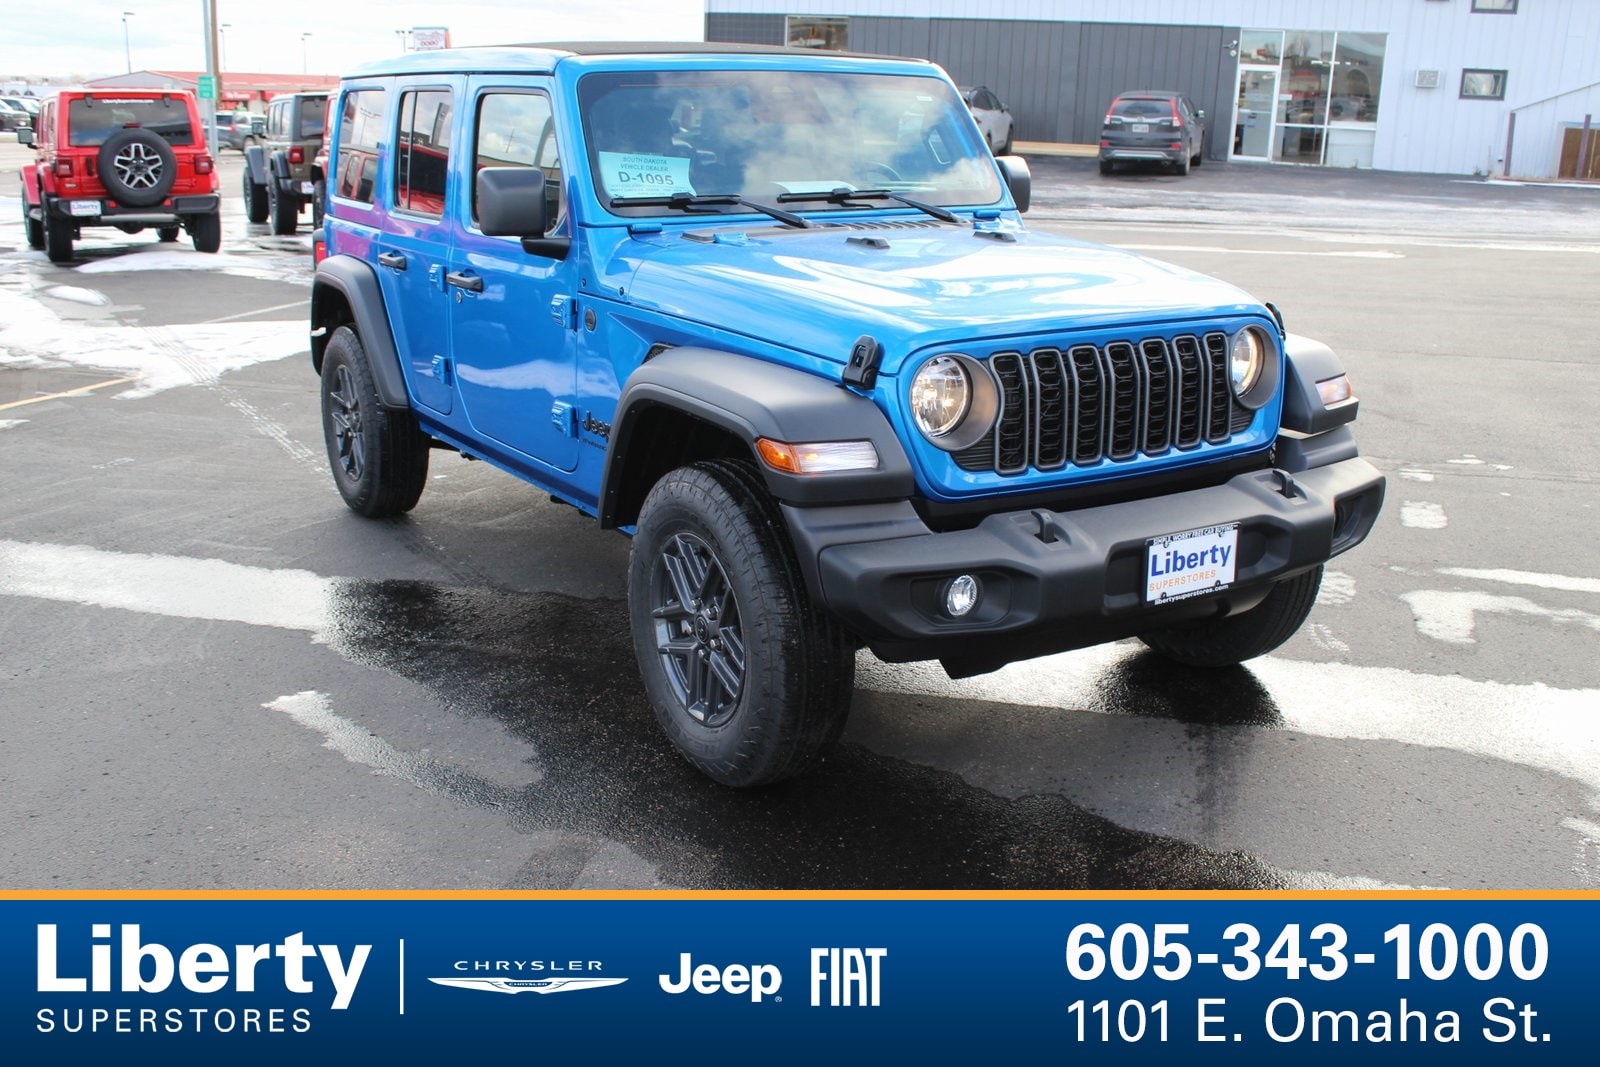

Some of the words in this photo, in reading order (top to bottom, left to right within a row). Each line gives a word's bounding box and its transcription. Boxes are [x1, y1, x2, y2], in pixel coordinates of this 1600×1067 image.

[620, 163, 644, 171] VEHICLE
[623, 156, 642, 164] SOUTH
[618, 171, 674, 185] D-1095
[1151, 544, 1231, 576] Liberty
[1149, 570, 1216, 591] SUPERSTORES
[1154, 585, 1228, 605] libertysuperstores.com
